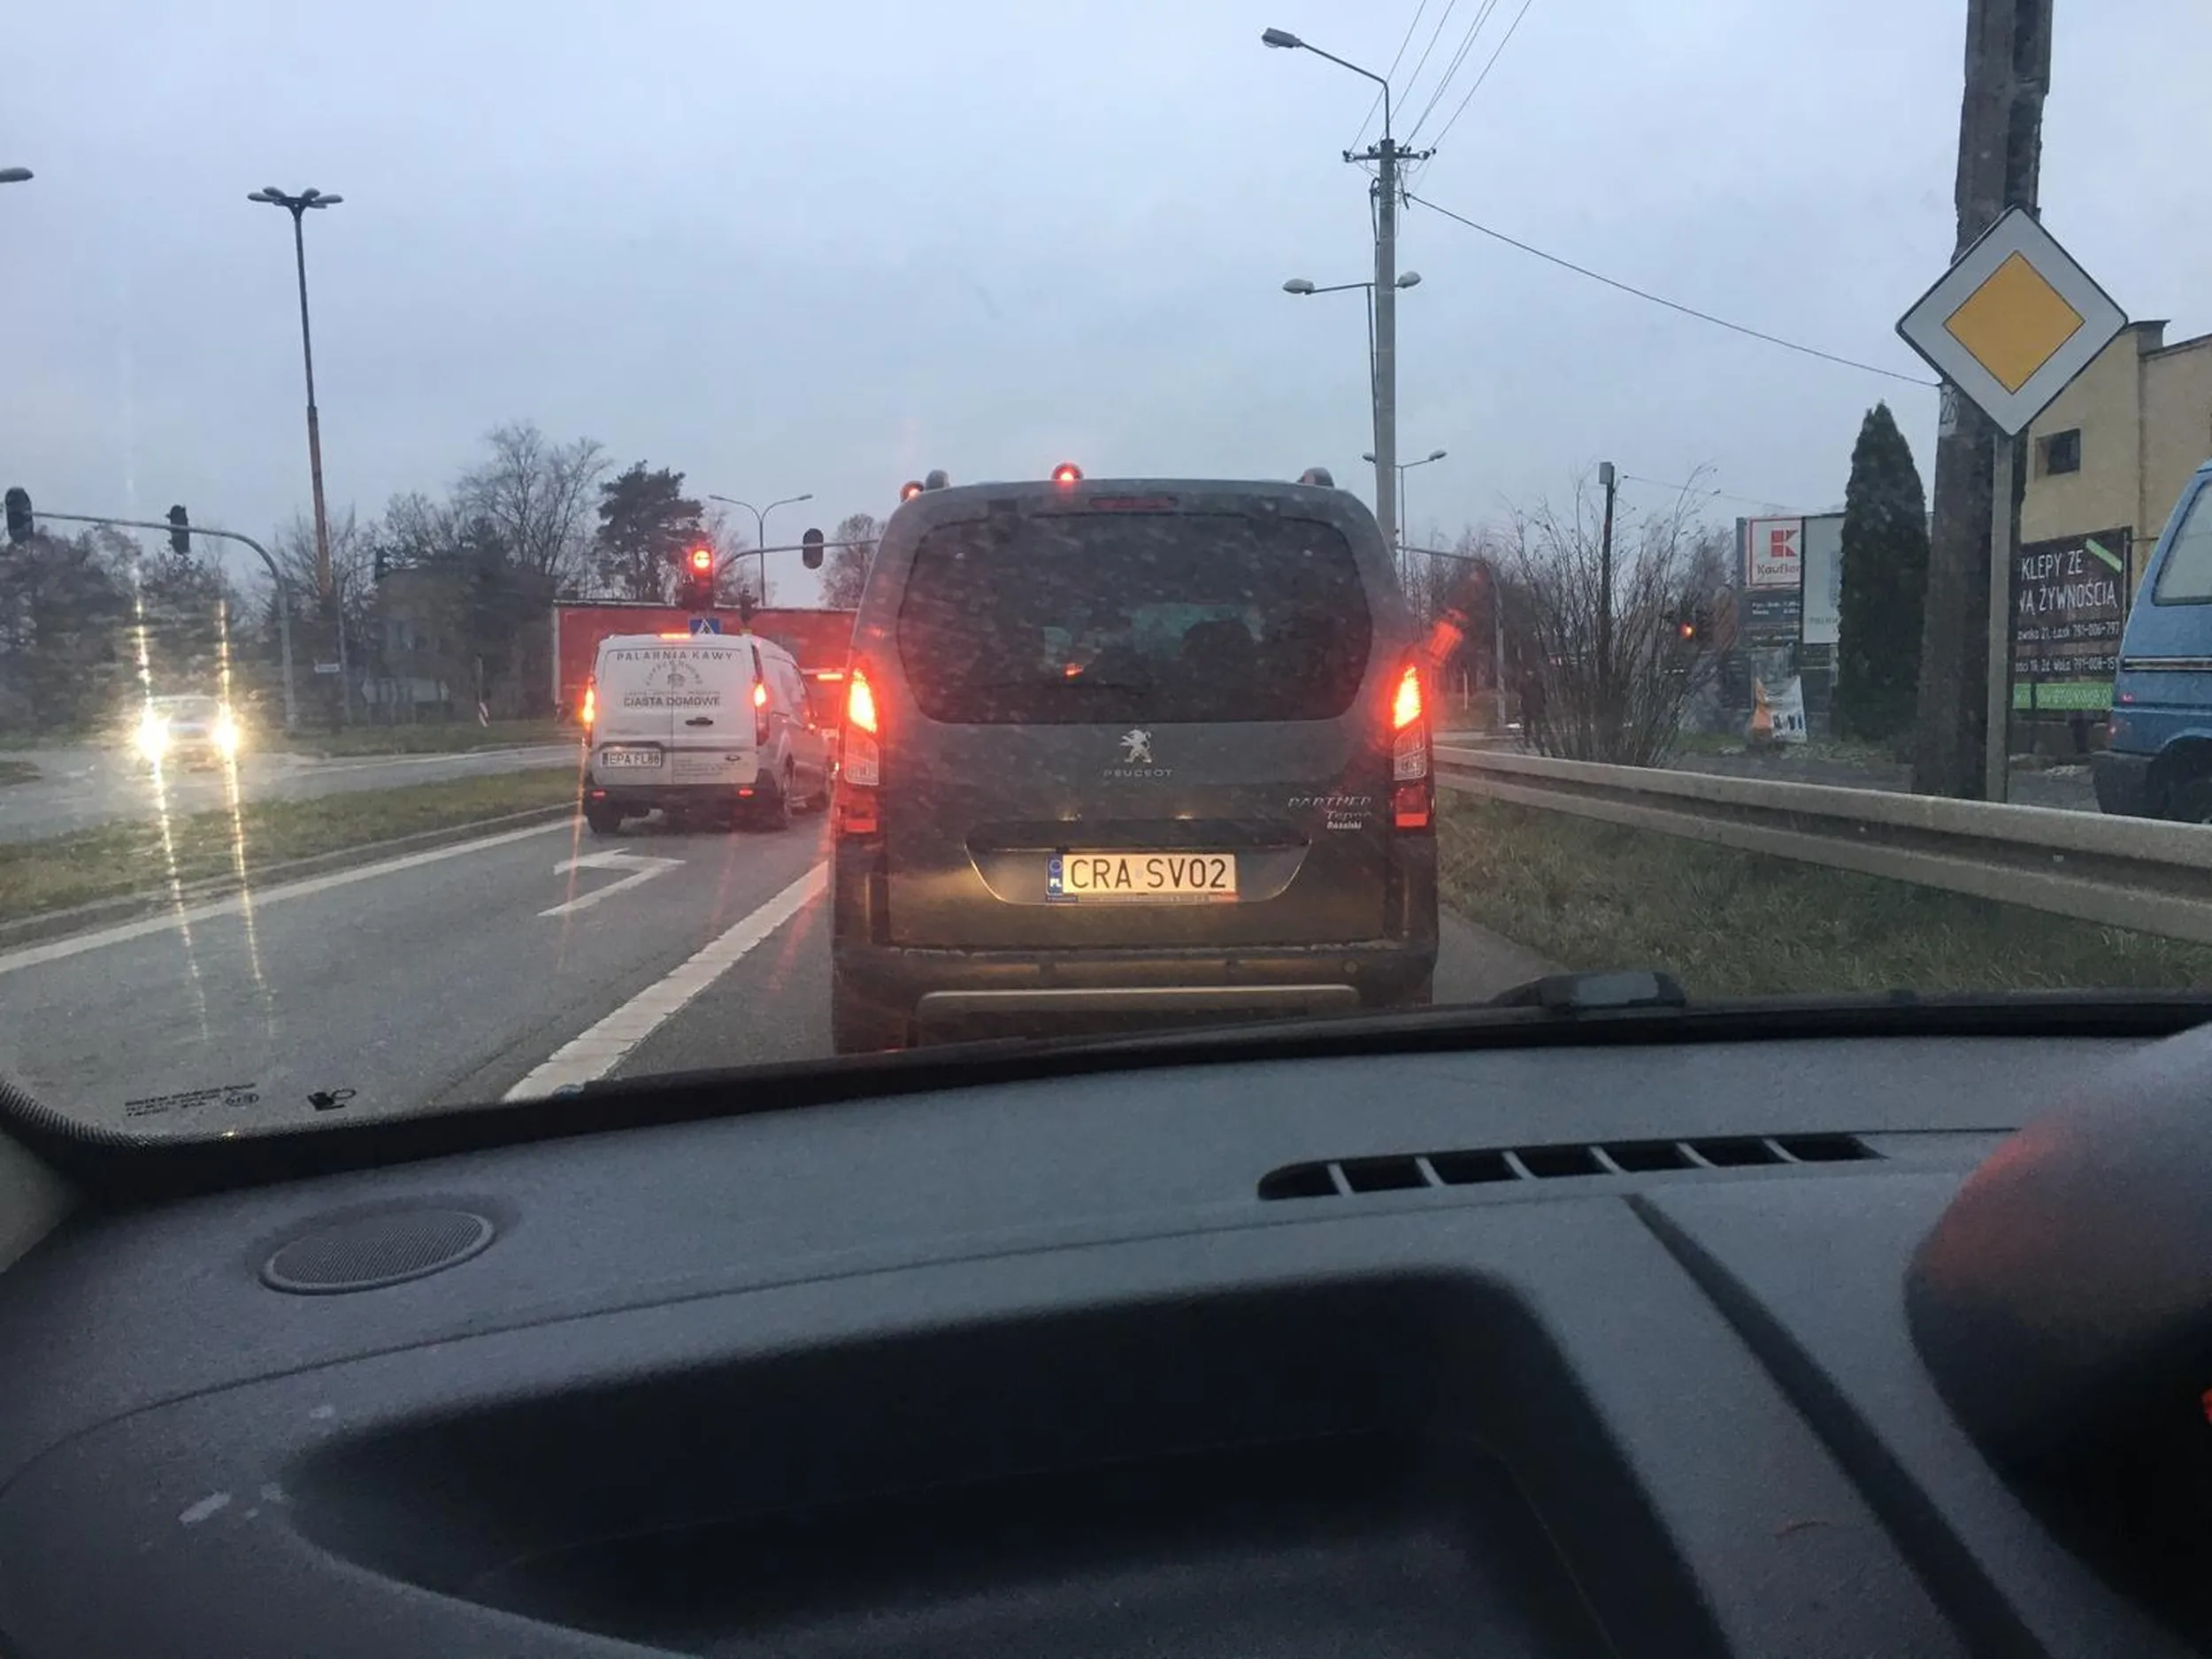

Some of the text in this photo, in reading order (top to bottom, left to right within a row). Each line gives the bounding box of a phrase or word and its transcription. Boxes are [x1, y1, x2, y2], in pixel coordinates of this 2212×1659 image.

[2021, 549, 2084, 580] KLEPY ZE
[2039, 578, 2118, 611] ŻYWNOŚCIĄ
[616, 650, 735, 661] PALARNIA KAWY
[624, 695, 721, 707] CIASTA DOMOWE
[1103, 768, 1173, 778] PEUGEOT
[1287, 795, 1372, 808] PARTNER
[1070, 857, 1226, 889] CRA SV02
